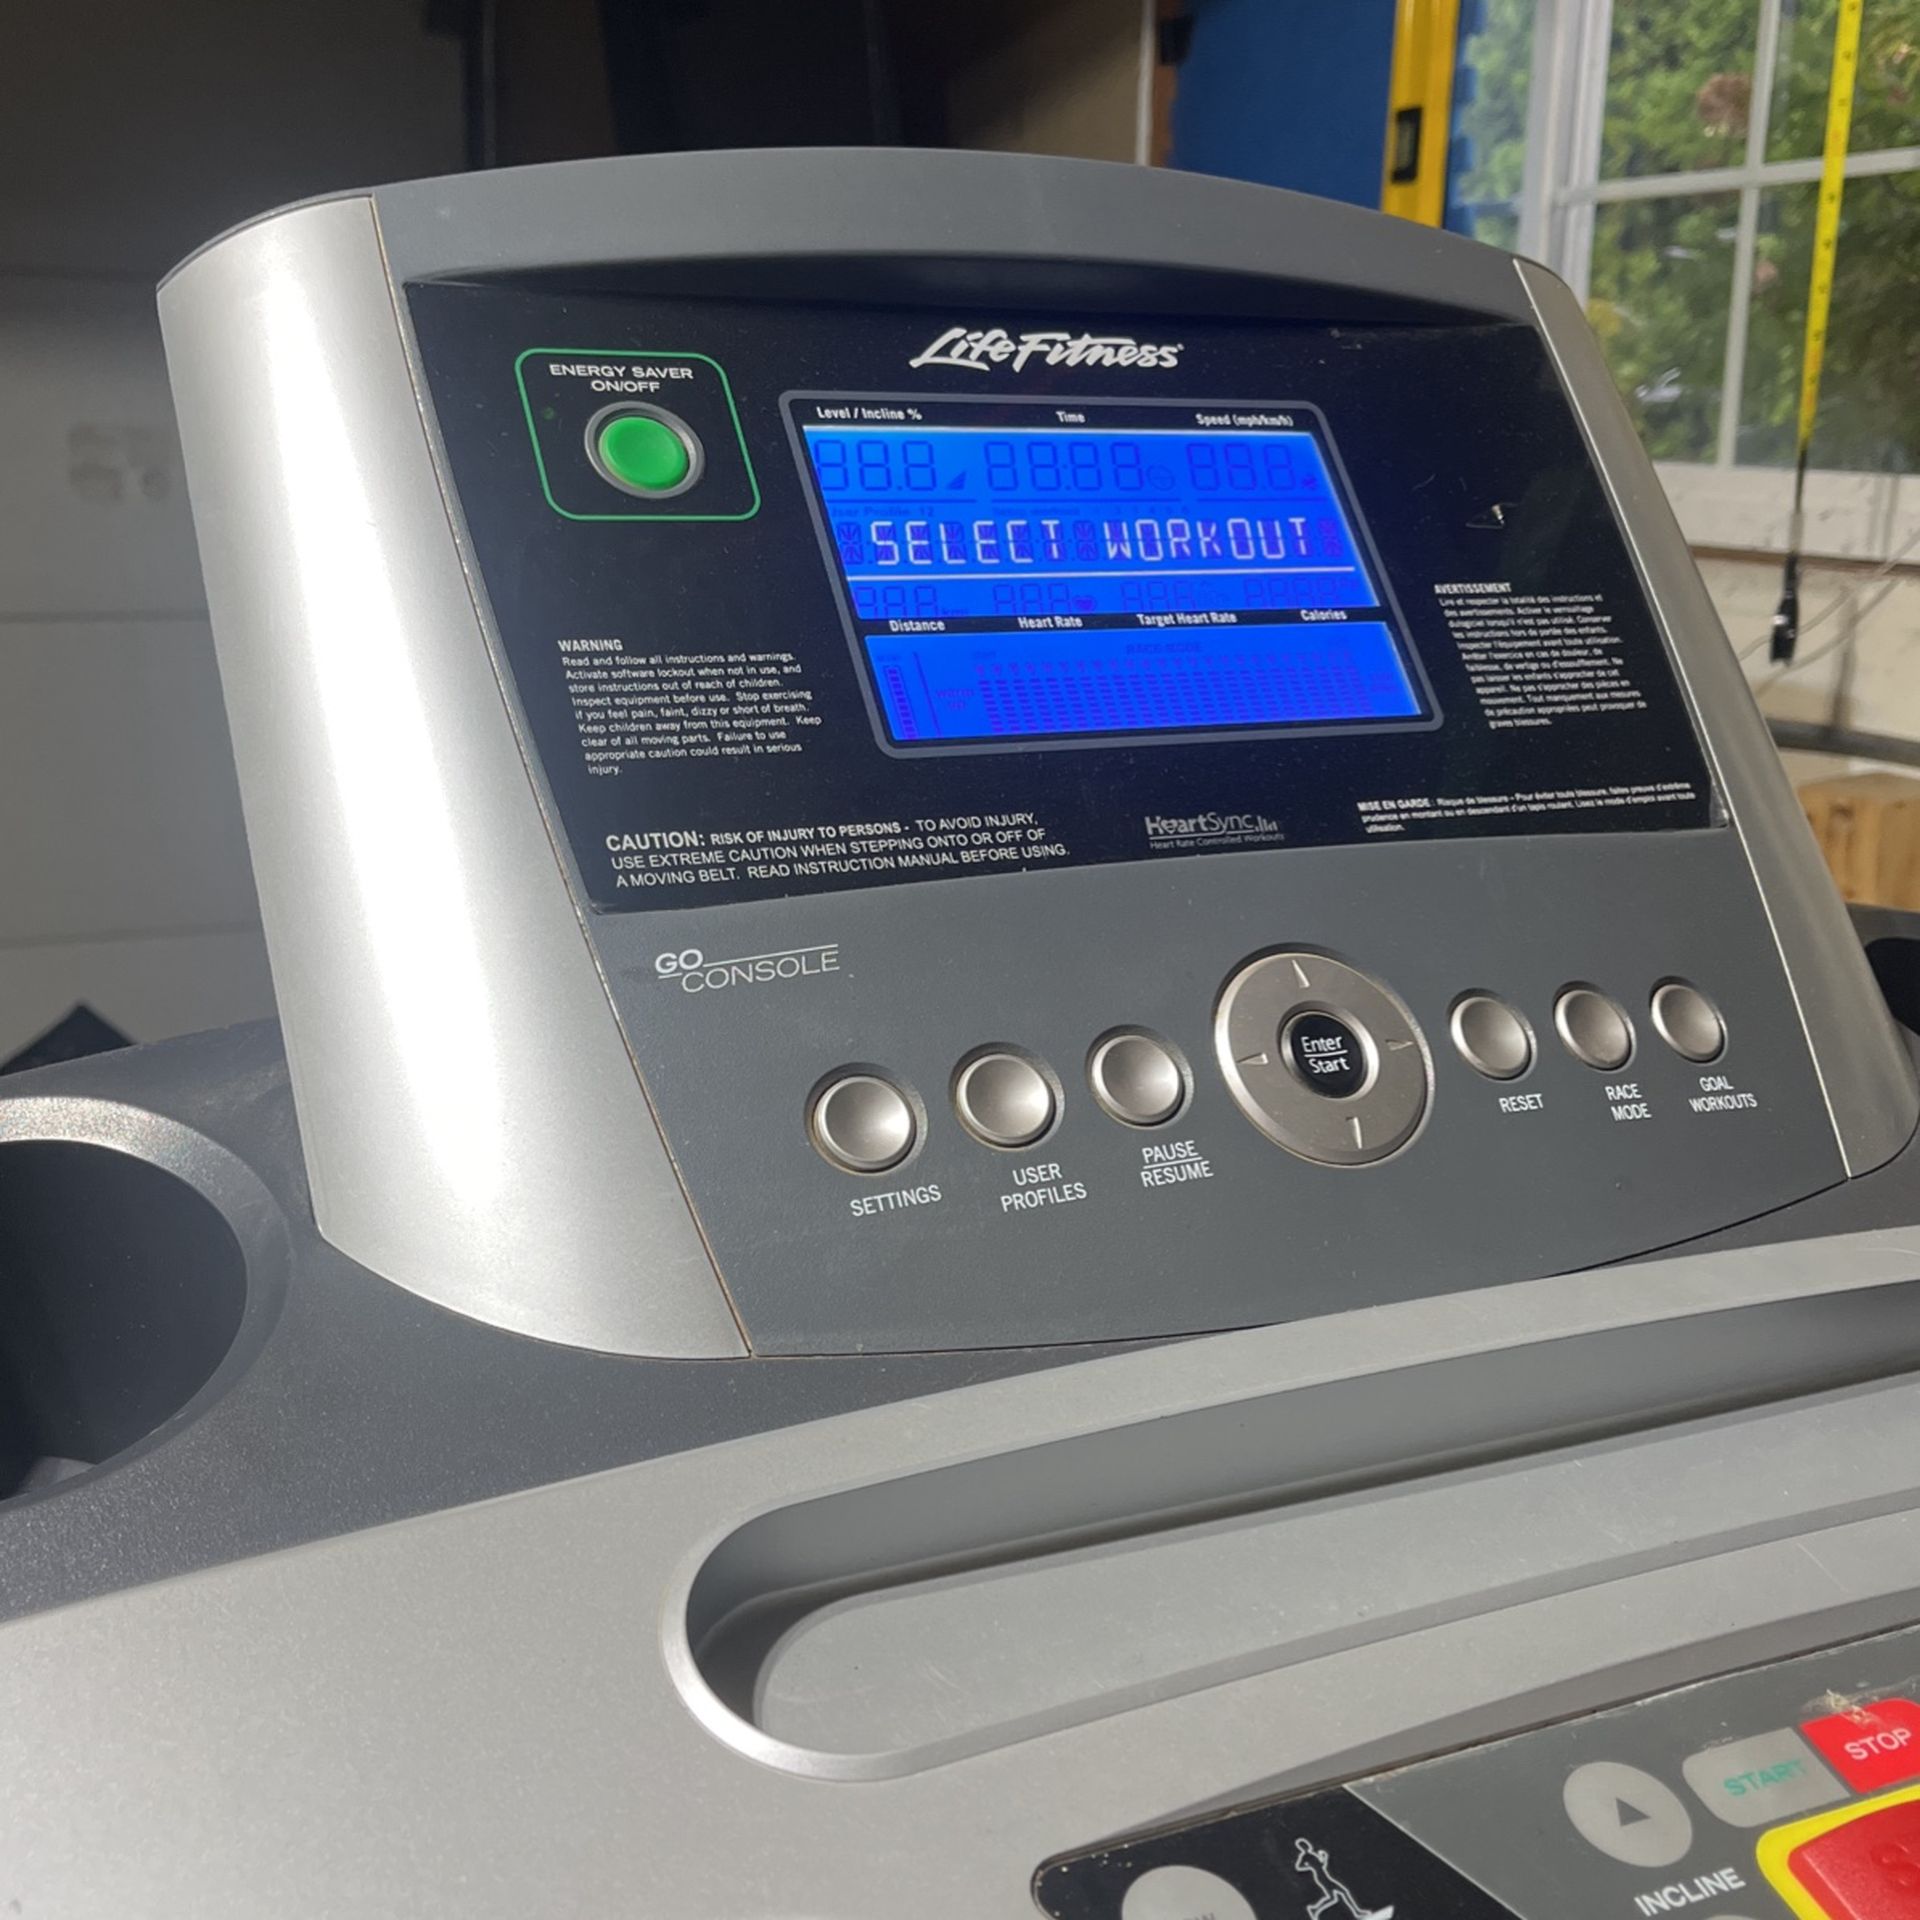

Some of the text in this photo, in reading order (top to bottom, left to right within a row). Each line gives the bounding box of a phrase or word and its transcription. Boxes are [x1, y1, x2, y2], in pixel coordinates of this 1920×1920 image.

[550, 364, 694, 380] ENERGY SAVER
[590, 380, 660, 393] ON/OFF
[816, 406, 851, 419] Level
[861, 408, 905, 420] Incline
[1056, 410, 1086, 423] Time
[1195, 413, 1231, 427] Speed
[869, 517, 1308, 566] SELECT WORKOUT
[1017, 615, 1083, 629] Heart Rate
[1136, 612, 1237, 628] Target Heart Rate
[1300, 609, 1348, 621] Calories
[888, 619, 945, 632] Distance
[557, 640, 623, 651] WARNING
[561, 652, 795, 666] Read and follow all instructions and warnings.
[564, 669, 608, 679] Activate
[610, 668, 655, 678] software
[656, 667, 695, 676] lockout
[696, 666, 725, 675] when
[726, 665, 744, 674] not
[746, 665, 756, 674] in
[782, 664, 801, 673] and
[567, 677, 782, 692] store instructions out of reach of children.
[571, 696, 612, 707] Inspect
[613, 694, 671, 706] equipment
[672, 693, 706, 702] before
[735, 691, 760, 703] Stop
[761, 690, 812, 702] exercising
[574, 710, 583, 719] if
[585, 712, 605, 720] you
[606, 709, 628, 718] feel
[630, 708, 658, 719] pain,
[659, 707, 688, 717] faint,
[690, 706, 718, 717] dizzy
[732, 704, 759, 714] short
[760, 704, 770, 713] of
[772, 703, 809, 712] breath.
[578, 716, 822, 734] Keep children away from this equipment. Keep
[580, 737, 608, 746] clear
[609, 736, 621, 745] of
[624, 735, 638, 745] all
[640, 734, 679, 746] moving
[680, 733, 711, 744] parts.
[716, 731, 752, 741] Failure
[754, 730, 766, 740] to
[584, 742, 802, 762] appropriate caution could result in serious
[587, 763, 622, 776] injury.
[605, 830, 705, 851] CAUTION:
[709, 831, 744, 845] RISK
[745, 830, 764, 843] OF
[766, 826, 814, 842] INJURY
[816, 825, 836, 838] TO
[838, 821, 901, 837] PERSONS
[915, 818, 936, 832] TO
[938, 815, 981, 830] AVOID
[610, 828, 1045, 870] USE EXTREME CAUTION WHEN STEPPING ONTO OR OFF OF
[1149, 839, 1174, 849] Heart
[615, 843, 1069, 888] A MOVING BELT. READ INSTRUCTION MANUAL BEFORE USING.
[654, 948, 704, 976] GO
[681, 950, 841, 993] CONSOLE
[1301, 1034, 1343, 1054] Enter
[1308, 1056, 1350, 1075] Start
[1604, 1083, 1642, 1101] RACE
[1699, 1076, 1734, 1092] GOAL
[1498, 1093, 1544, 1113] RESET
[1611, 1102, 1652, 1121] MODE
[1688, 1093, 1758, 1112] WORKOUTS
[1142, 1141, 1199, 1164] PAUSE
[1012, 1163, 1062, 1187] USER
[1140, 1160, 1213, 1188] RESUME
[849, 1184, 942, 1217] SETTINGS
[1000, 1182, 1087, 1212] PROFILES
[1844, 1727, 1912, 1760] STOP
[1722, 1758, 1808, 1797] START
[1634, 1867, 1746, 1917] INCLINE
